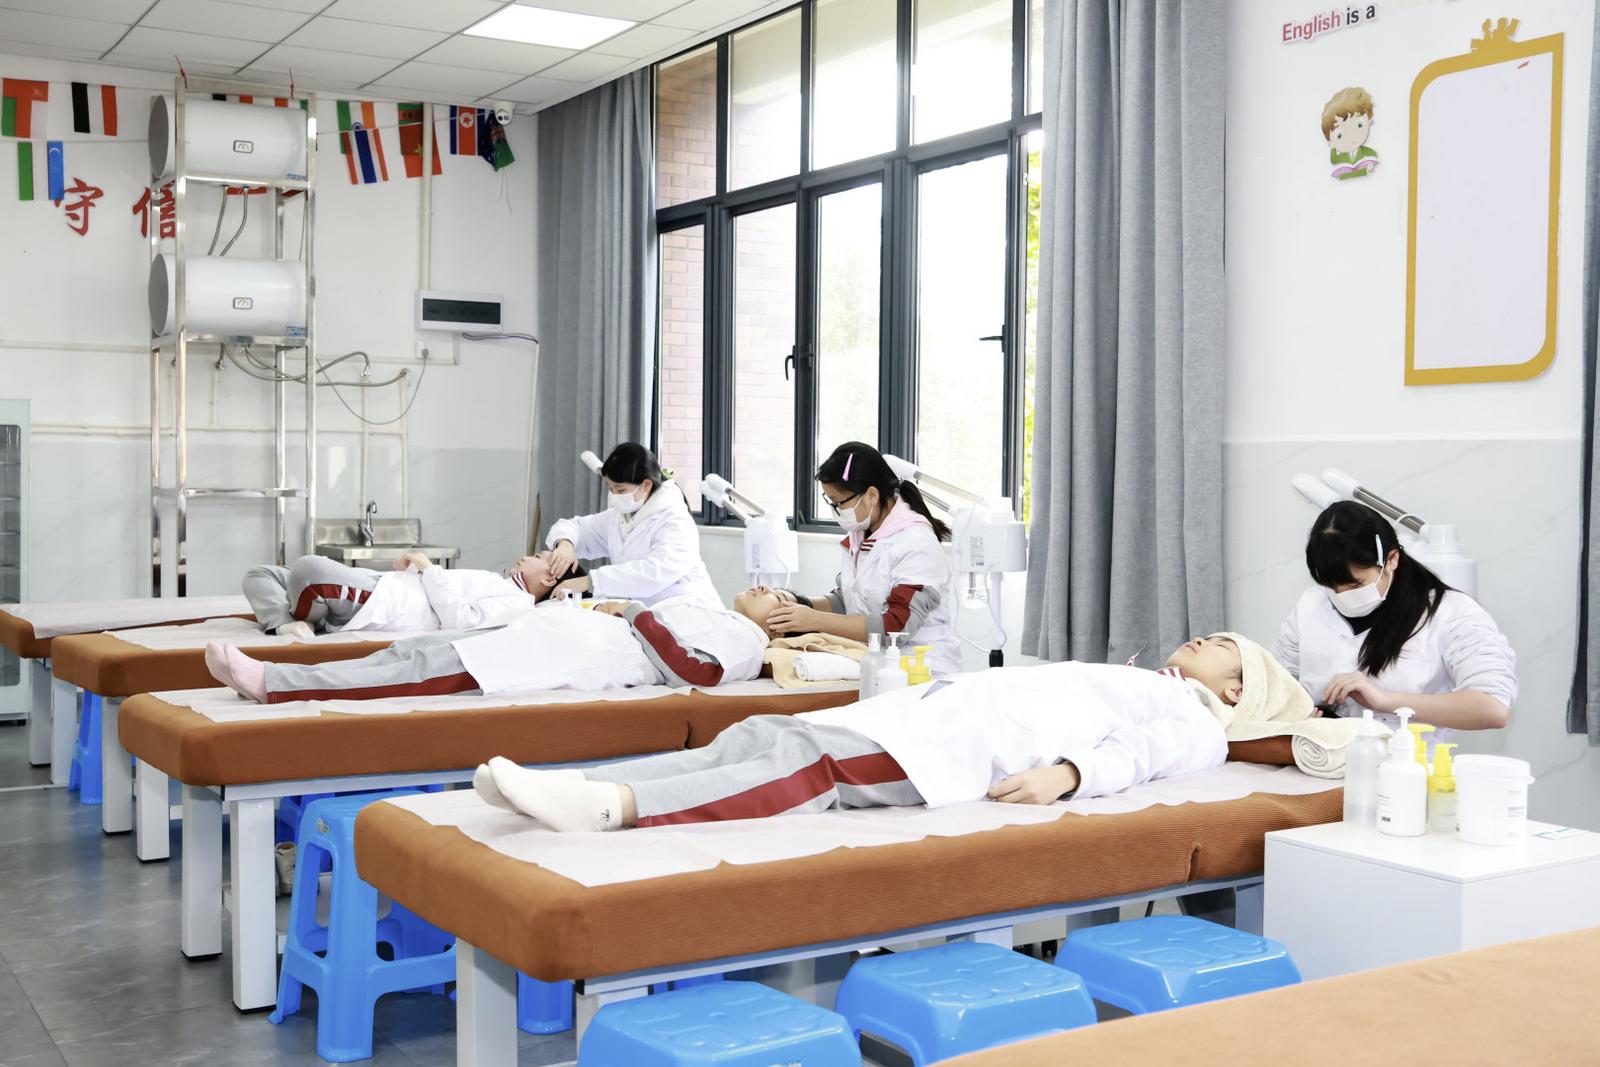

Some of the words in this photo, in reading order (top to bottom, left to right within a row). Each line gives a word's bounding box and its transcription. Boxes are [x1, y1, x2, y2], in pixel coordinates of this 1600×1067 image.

[1282, 11, 1341, 42] English
[1346, 7, 1360, 25] is
[1366, 4, 1376, 20] a
